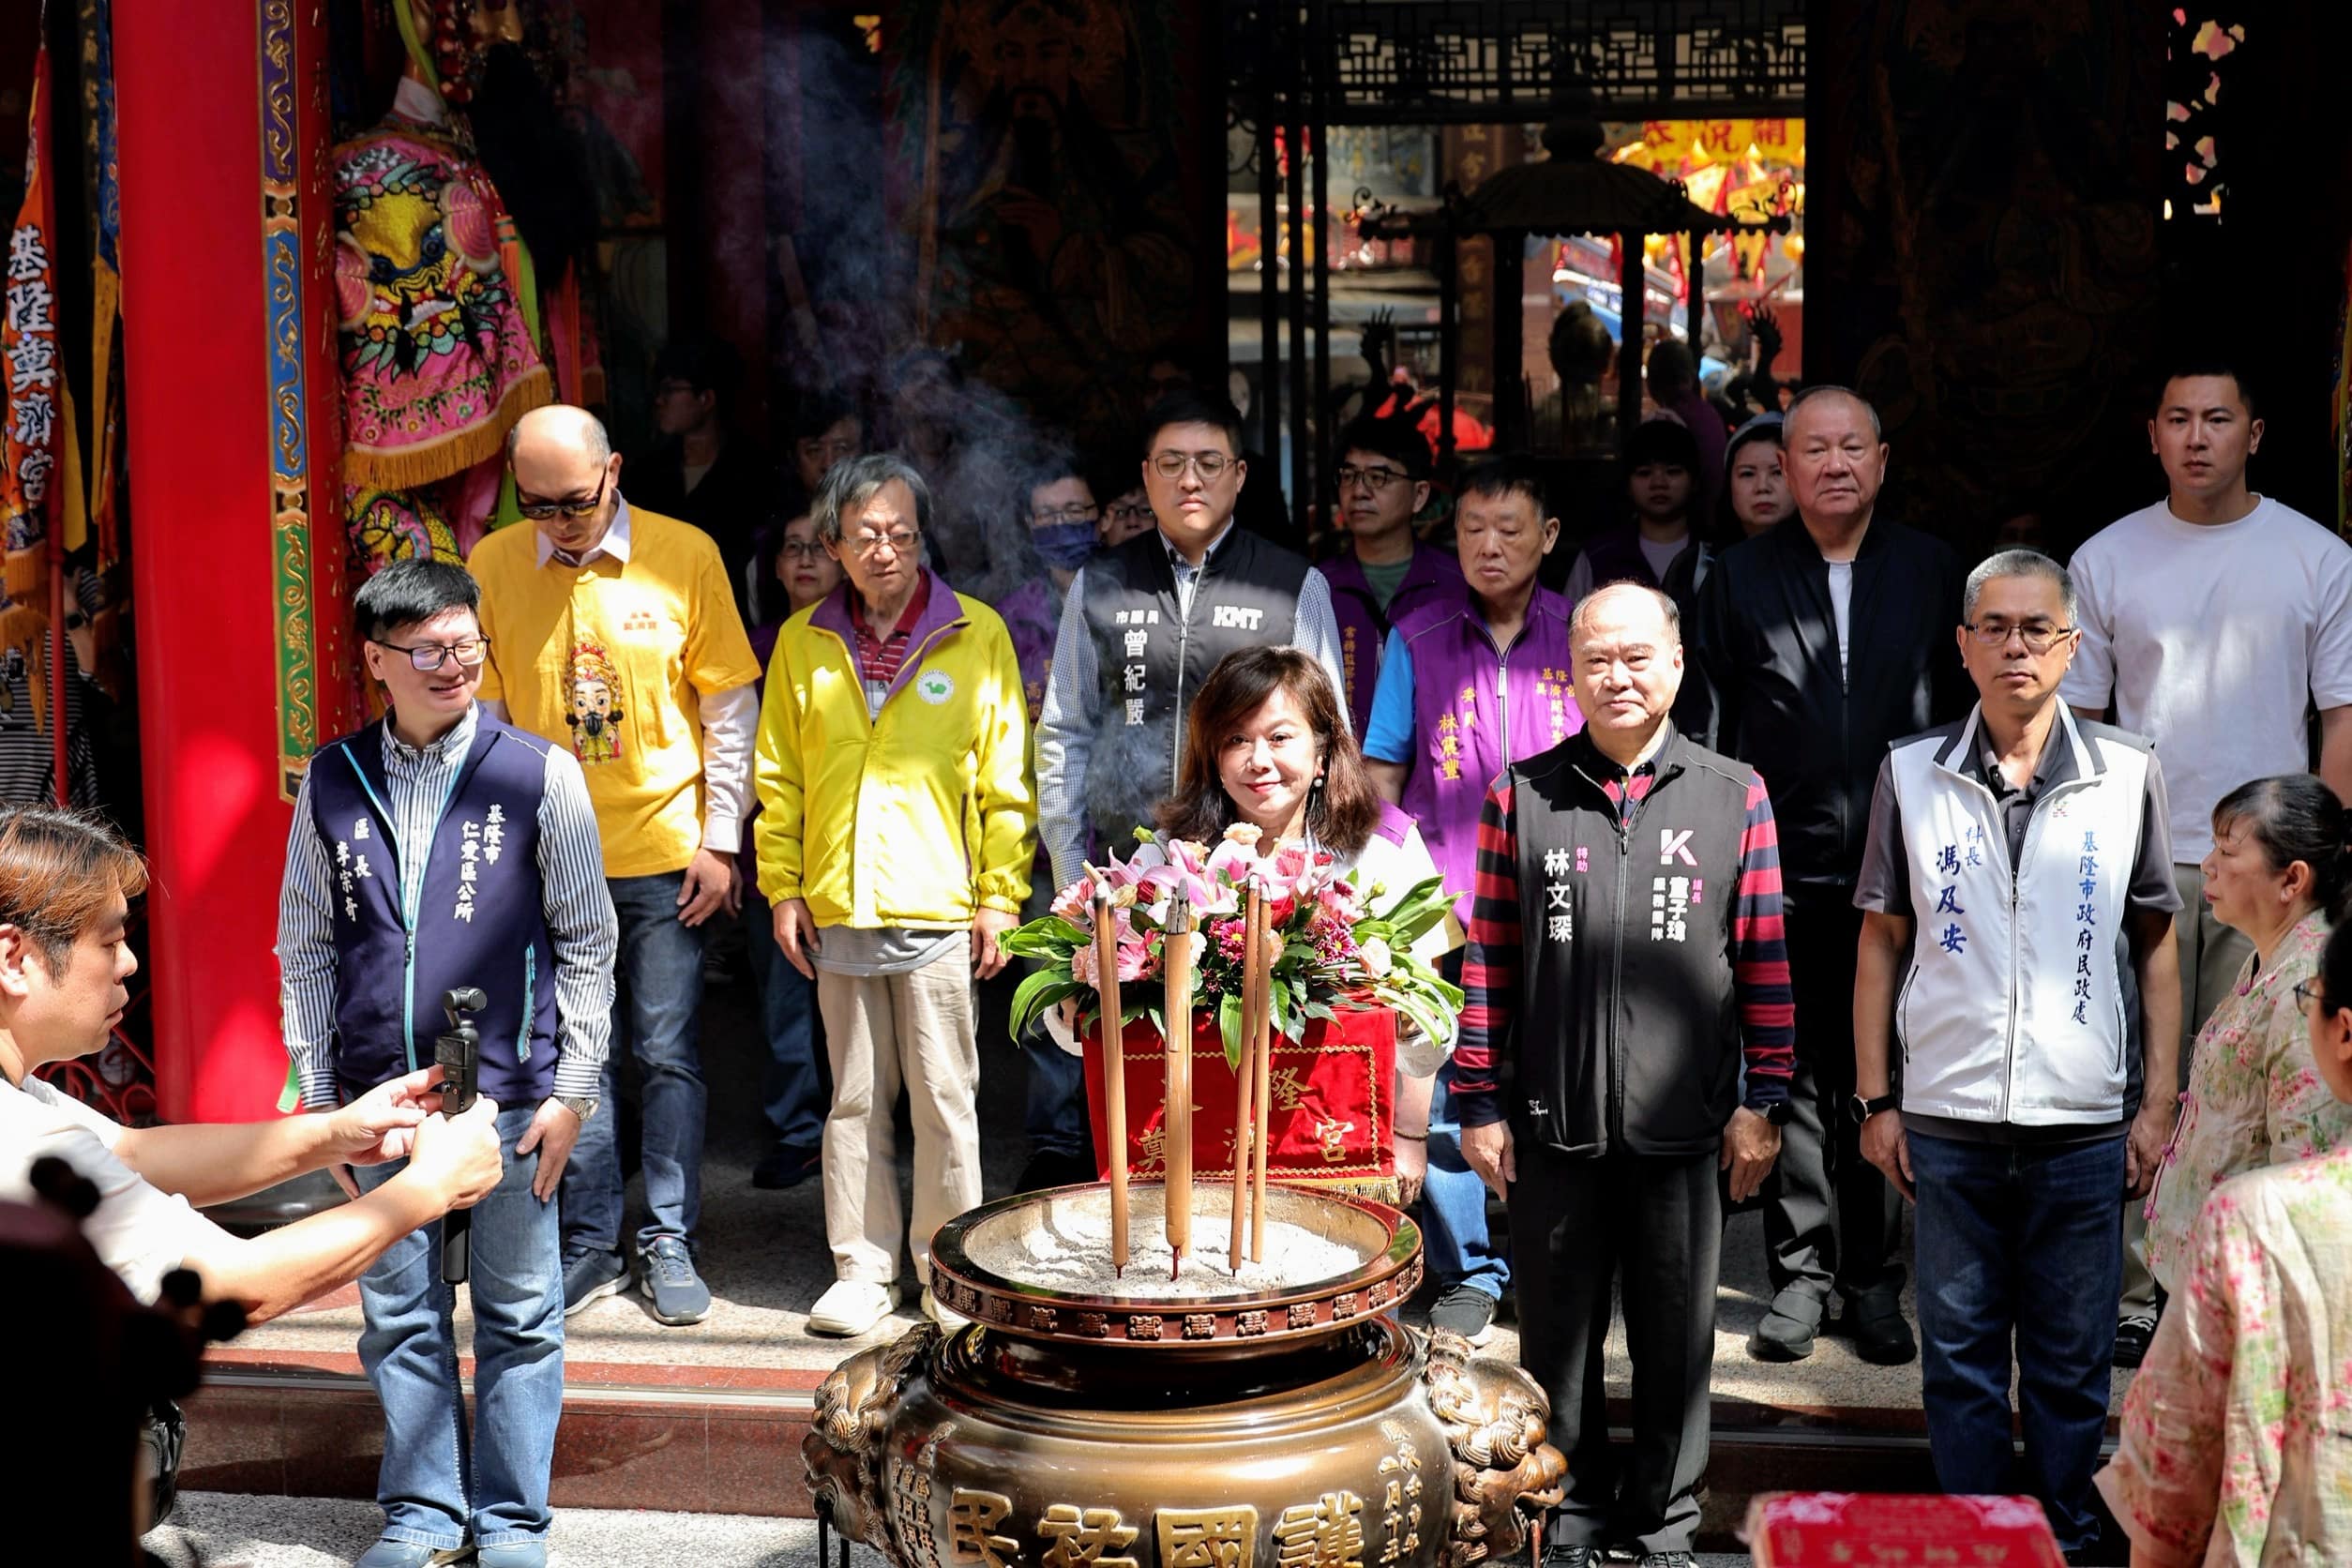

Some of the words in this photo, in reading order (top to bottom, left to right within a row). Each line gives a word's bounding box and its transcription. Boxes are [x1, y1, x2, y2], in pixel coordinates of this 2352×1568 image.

[7, 224, 54, 502] 基隆奠濟宮
[1115, 610, 1159, 625] 市議員
[1213, 606, 1263, 630] KMT
[1123, 628, 1148, 726] 曾紀嚴
[1535, 682, 1576, 699] 奠濟宮
[1541, 668, 1568, 683] 基隆
[1461, 686, 1476, 728] 委員
[354, 817, 372, 879] 區長
[483, 804, 506, 866] 基隆市
[1576, 847, 1589, 872] 特助
[1660, 829, 1698, 866] K
[1965, 824, 1983, 868] 科長
[336, 840, 358, 923] 李宗奇
[453, 820, 481, 923] 仁愛區公所
[1545, 848, 1573, 942] 林文琛
[1936, 844, 1968, 954] 馮及安
[1651, 877, 1666, 942] 服務團隊
[2071, 830, 2100, 1025] 基隆市政府民政處
